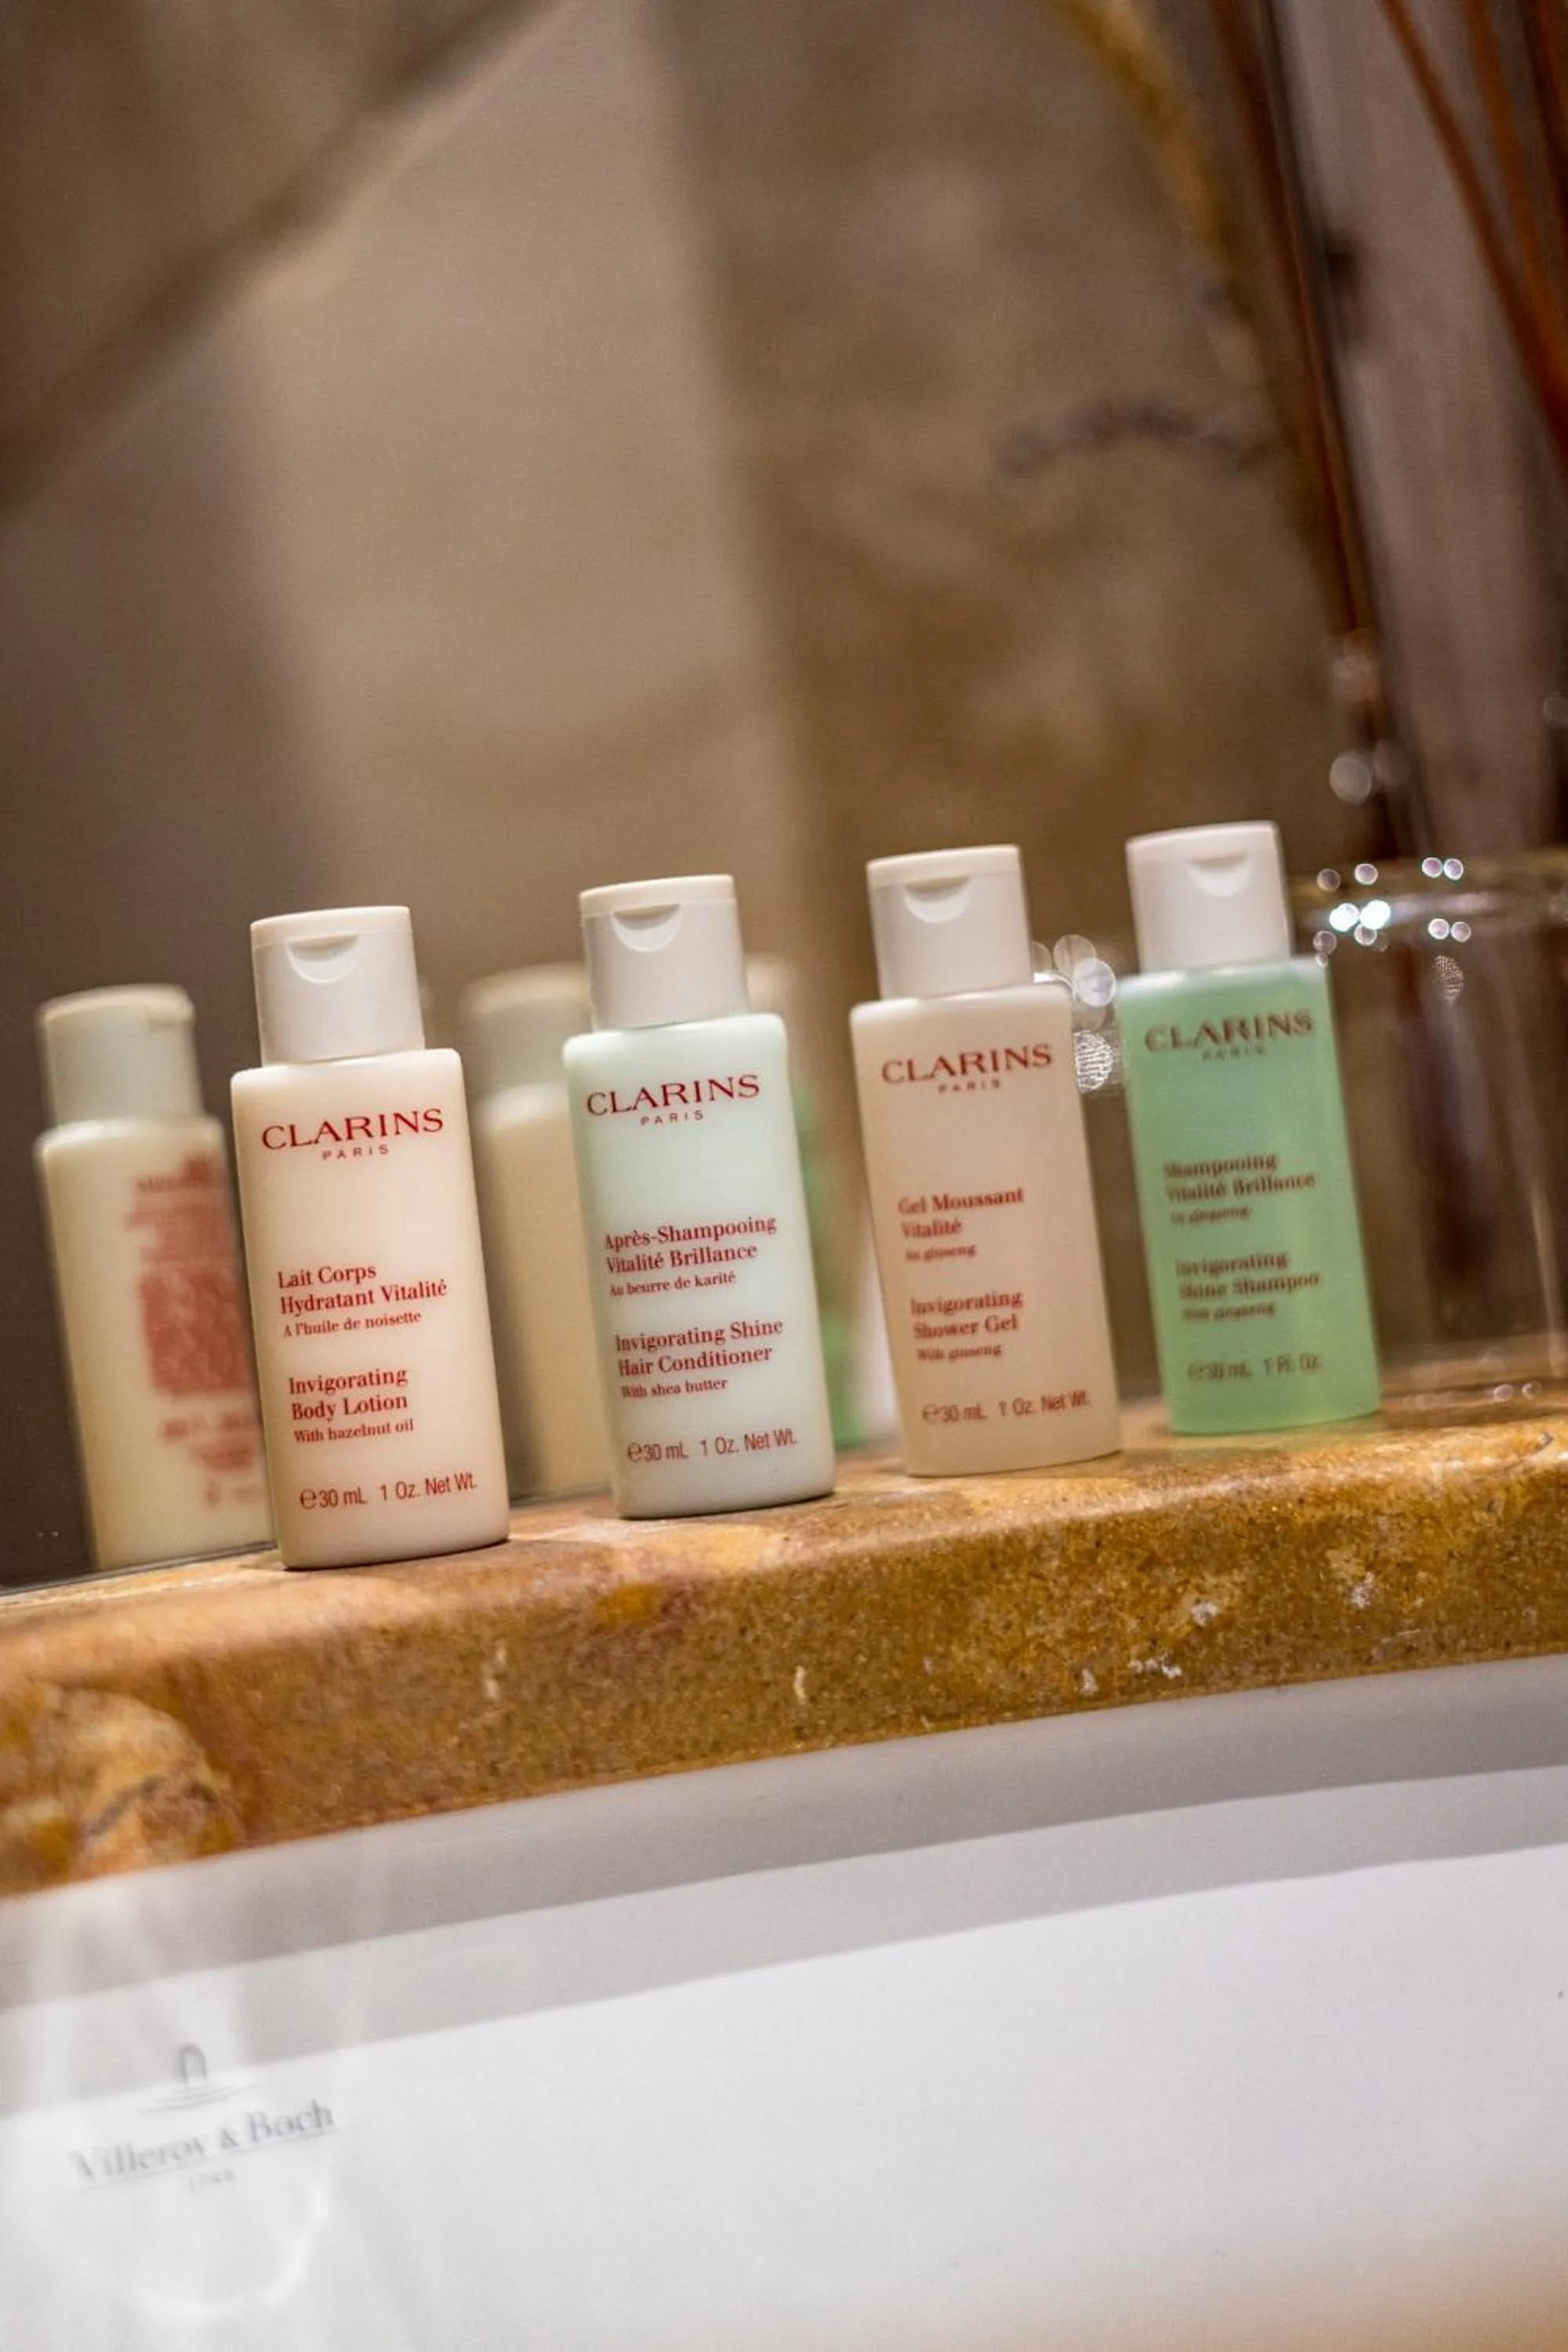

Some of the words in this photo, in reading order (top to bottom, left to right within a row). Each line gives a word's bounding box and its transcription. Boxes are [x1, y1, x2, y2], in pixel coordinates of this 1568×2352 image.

[1145, 1008, 1315, 1052] CLARINS
[881, 1043, 1052, 1084] CLARINS
[586, 1073, 760, 1116] CLARINS
[938, 1079, 1000, 1094] PARIS
[262, 1108, 444, 1150] CLARINS
[641, 1109, 703, 1126] PARIS
[322, 1145, 389, 1160] PARIS
[898, 1196, 926, 1214] Gel
[931, 1186, 1024, 1210] Moussant
[604, 1216, 778, 1253] Après-Shampooing
[902, 1217, 963, 1238] Vitalité
[606, 1252, 664, 1274] Vitalité
[670, 1244, 758, 1268] Brillance
[278, 1269, 313, 1289] Lait
[318, 1265, 376, 1284] Corps
[611, 1284, 624, 1297] Au
[627, 1279, 672, 1295] beurre
[674, 1276, 691, 1290] de
[695, 1271, 736, 1287] karité
[281, 1290, 374, 1317] Hydratant
[381, 1279, 448, 1302] Vitalité
[910, 1291, 1022, 1316] Invigorating
[343, 1317, 361, 1330] de
[365, 1311, 421, 1329] noisette
[913, 1320, 978, 1339] Shower
[985, 1314, 1018, 1333] Gel
[616, 1327, 725, 1352] Invigorating
[730, 1319, 783, 1340] Shine
[619, 1358, 653, 1377] Hair
[659, 1347, 772, 1374] Conditioner
[289, 1368, 408, 1396] Invigorating
[622, 1385, 648, 1399] With
[652, 1382, 681, 1396] shea
[685, 1378, 728, 1394] butter
[292, 1401, 336, 1422] Body
[343, 1394, 408, 1416] Lotion
[963, 1403, 988, 1421] mL
[998, 1399, 1006, 1417] 1
[294, 1428, 324, 1443] With
[328, 1421, 392, 1441] hazelnut
[395, 1417, 414, 1432] oil
[666, 1440, 689, 1460] mL
[700, 1439, 708, 1457] 1
[714, 1436, 739, 1455] Oz.
[745, 1432, 770, 1451] Net
[774, 1428, 797, 1446] Wt.
[343, 1486, 368, 1505] mL
[379, 1484, 388, 1502] 1
[395, 1480, 420, 1500] Oz.
[425, 1475, 451, 1497] Net
[454, 1472, 477, 1491] Wt.
[246, 2097, 335, 2144] Boch
